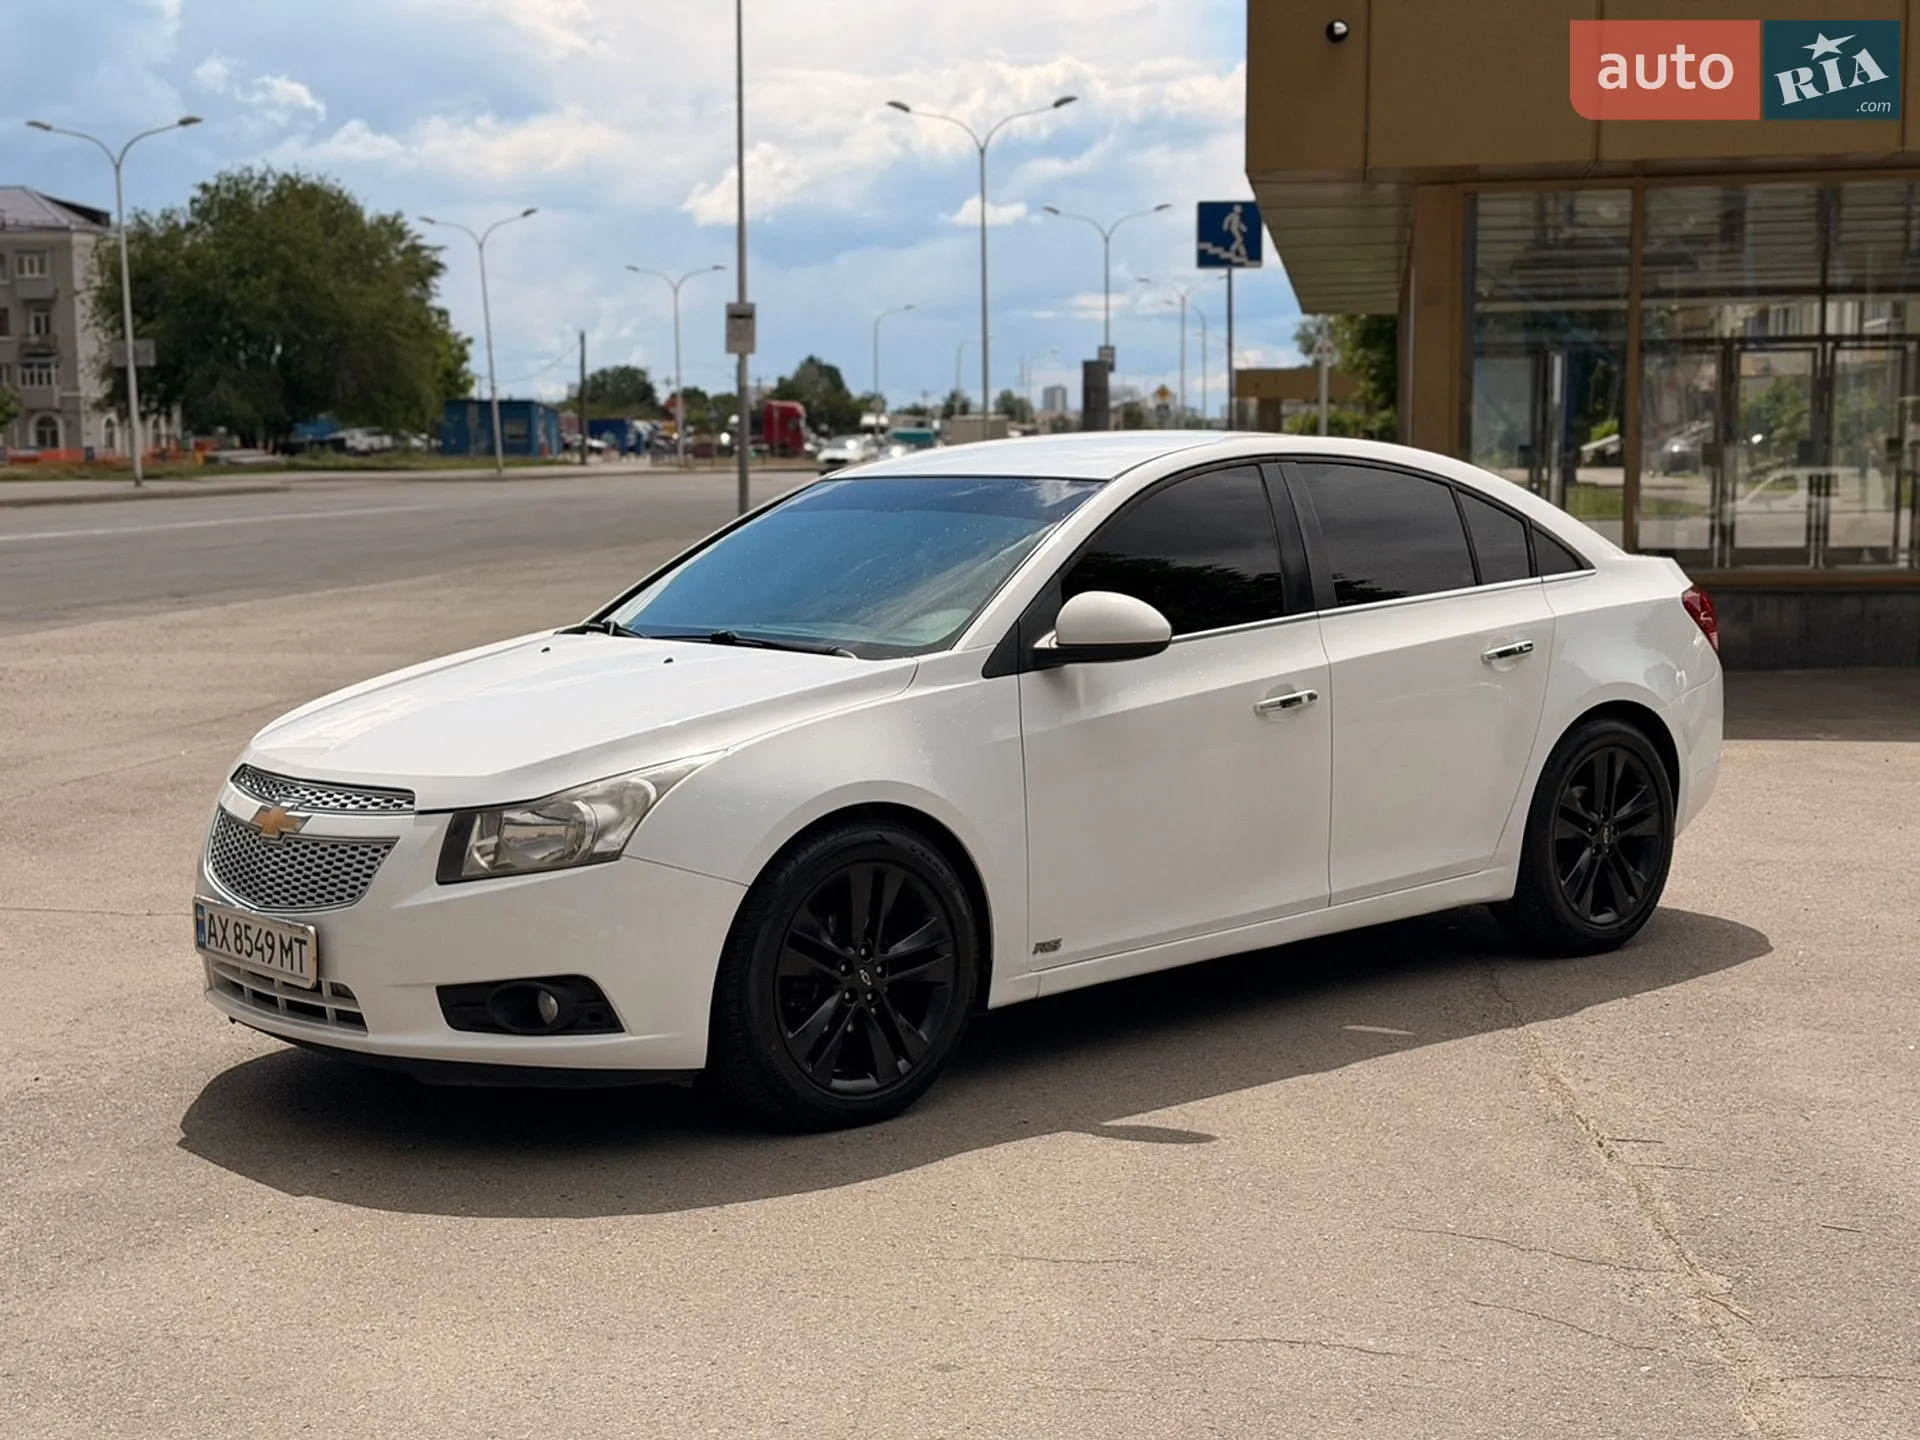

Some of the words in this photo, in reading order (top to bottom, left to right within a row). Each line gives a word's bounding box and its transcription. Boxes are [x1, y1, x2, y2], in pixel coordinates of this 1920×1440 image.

[207, 912, 231, 952] AX
[233, 921, 275, 964] 8549
[278, 933, 307, 974] MT
